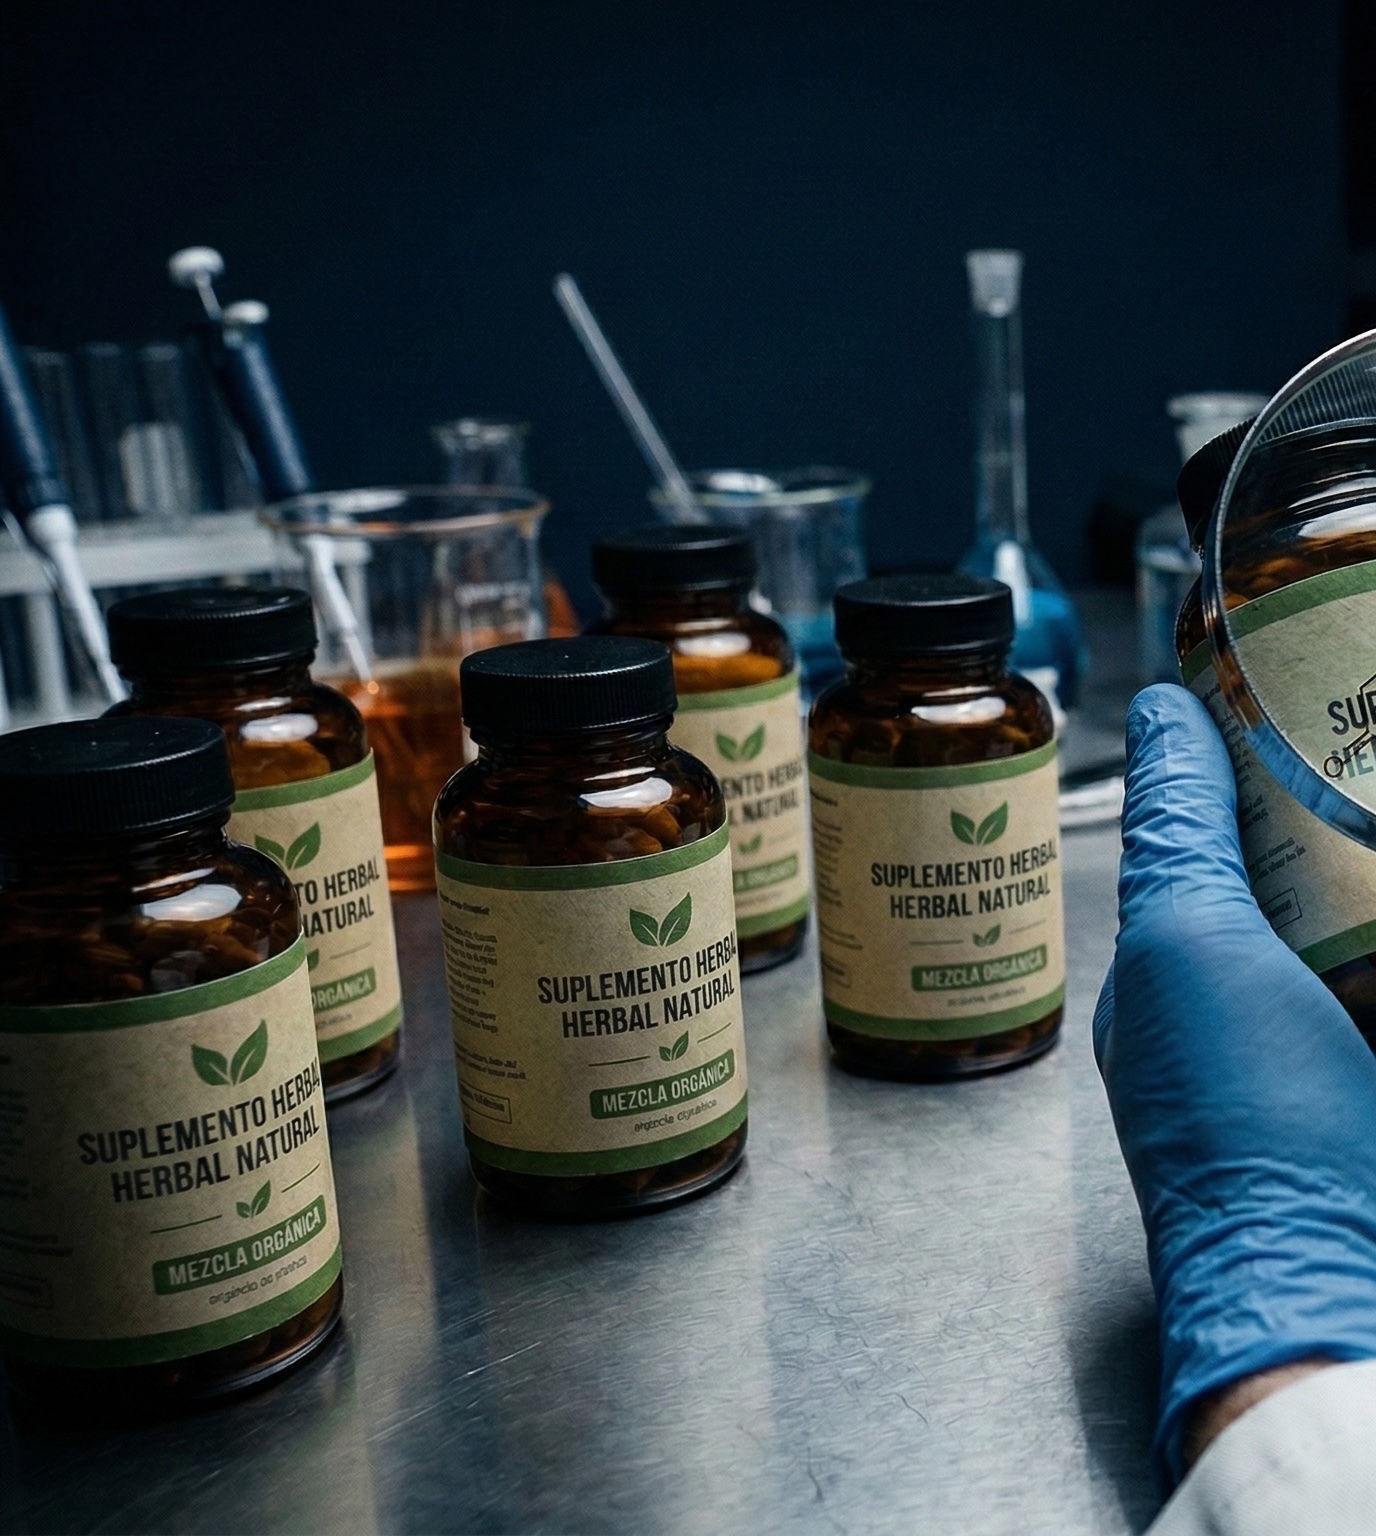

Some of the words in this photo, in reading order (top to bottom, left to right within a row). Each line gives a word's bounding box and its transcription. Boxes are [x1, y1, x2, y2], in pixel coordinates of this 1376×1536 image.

[324, 856, 380, 900] HERBAL
[870, 856, 1004, 889] SUPLEMENTO
[890, 891, 973, 919] HERBAL
[978, 872, 1051, 914] NATURAL
[537, 957, 691, 1004] SUPLEMENTO
[921, 966, 979, 987] MEZCLA
[562, 1003, 658, 1038] HERBAL
[664, 969, 735, 1024] NATURAL
[602, 1083, 668, 1113] MEZCLA
[671, 1057, 730, 1100] ORGÁNICA
[77, 1095, 267, 1165] SUPLEMENTO
[111, 1158, 230, 1203] HERBAL
[236, 1105, 321, 1176] NATURAL
[169, 1247, 248, 1286] MEZCLA
[252, 1206, 322, 1261] ORGÁNICA
